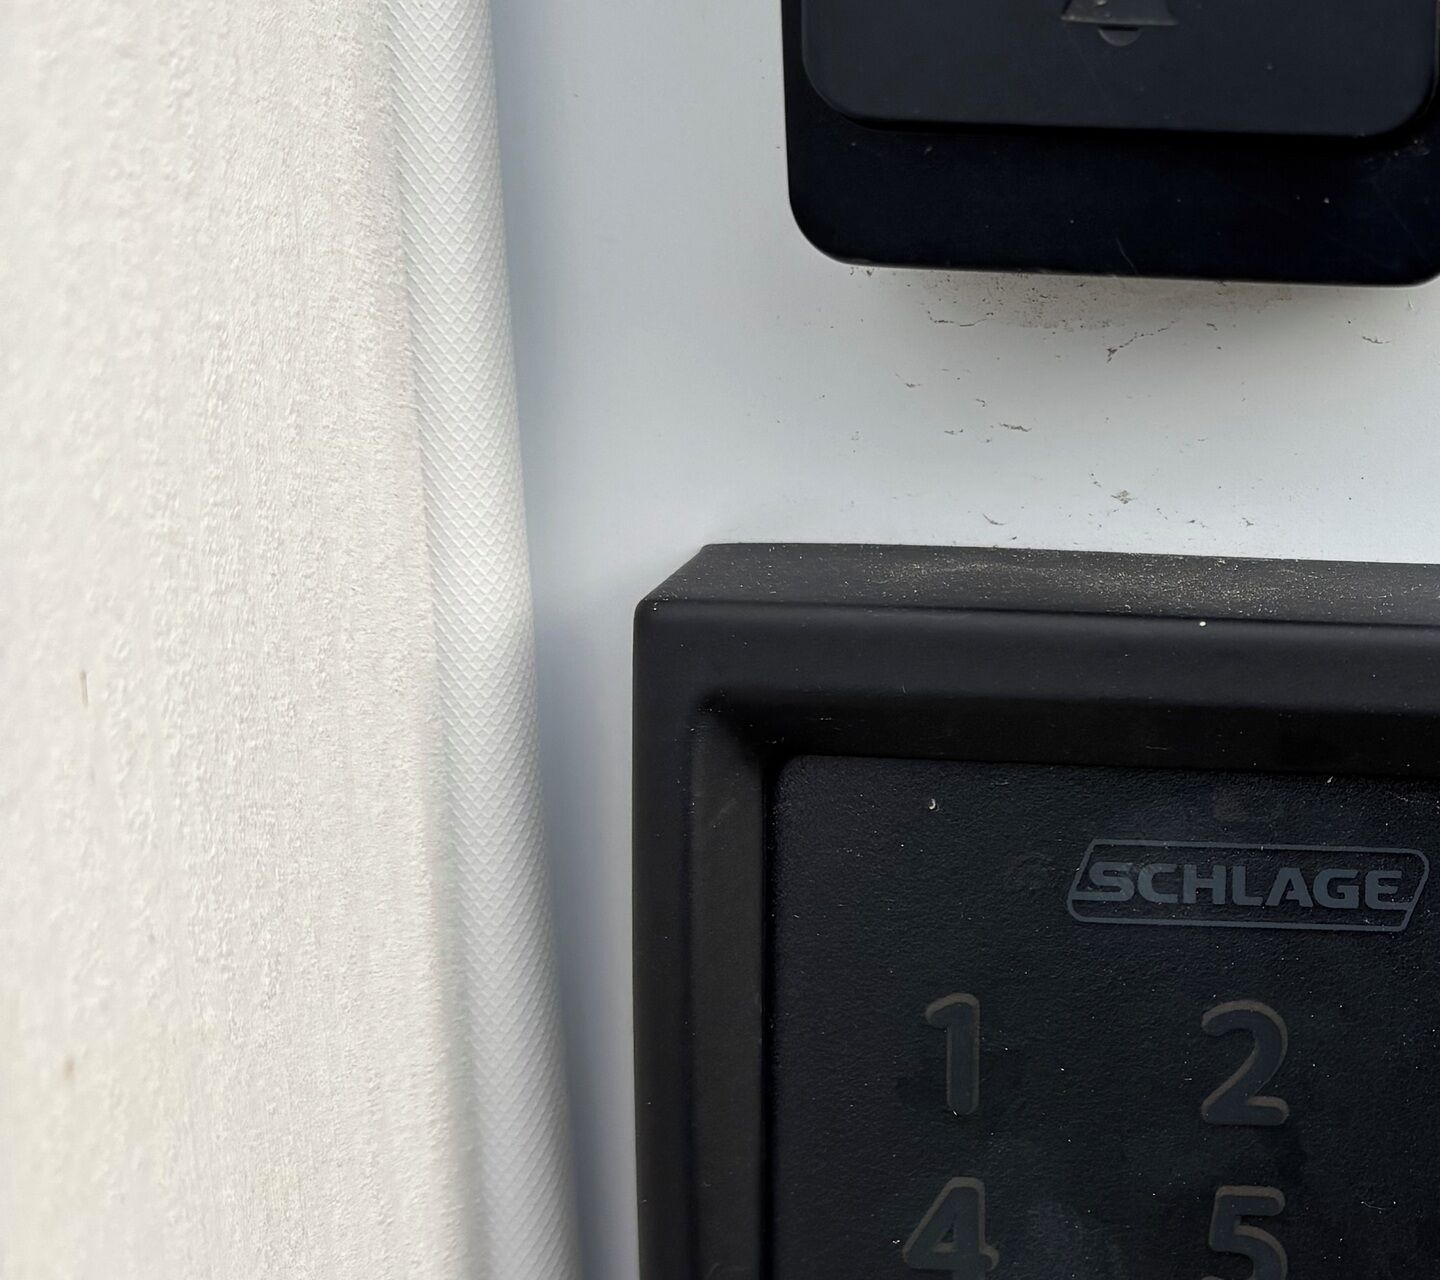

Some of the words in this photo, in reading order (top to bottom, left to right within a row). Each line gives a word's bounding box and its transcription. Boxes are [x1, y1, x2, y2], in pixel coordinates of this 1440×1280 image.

[1070, 860, 1420, 912] SCHLAGE
[925, 992, 981, 1116] 1
[1201, 999, 1290, 1127] 2
